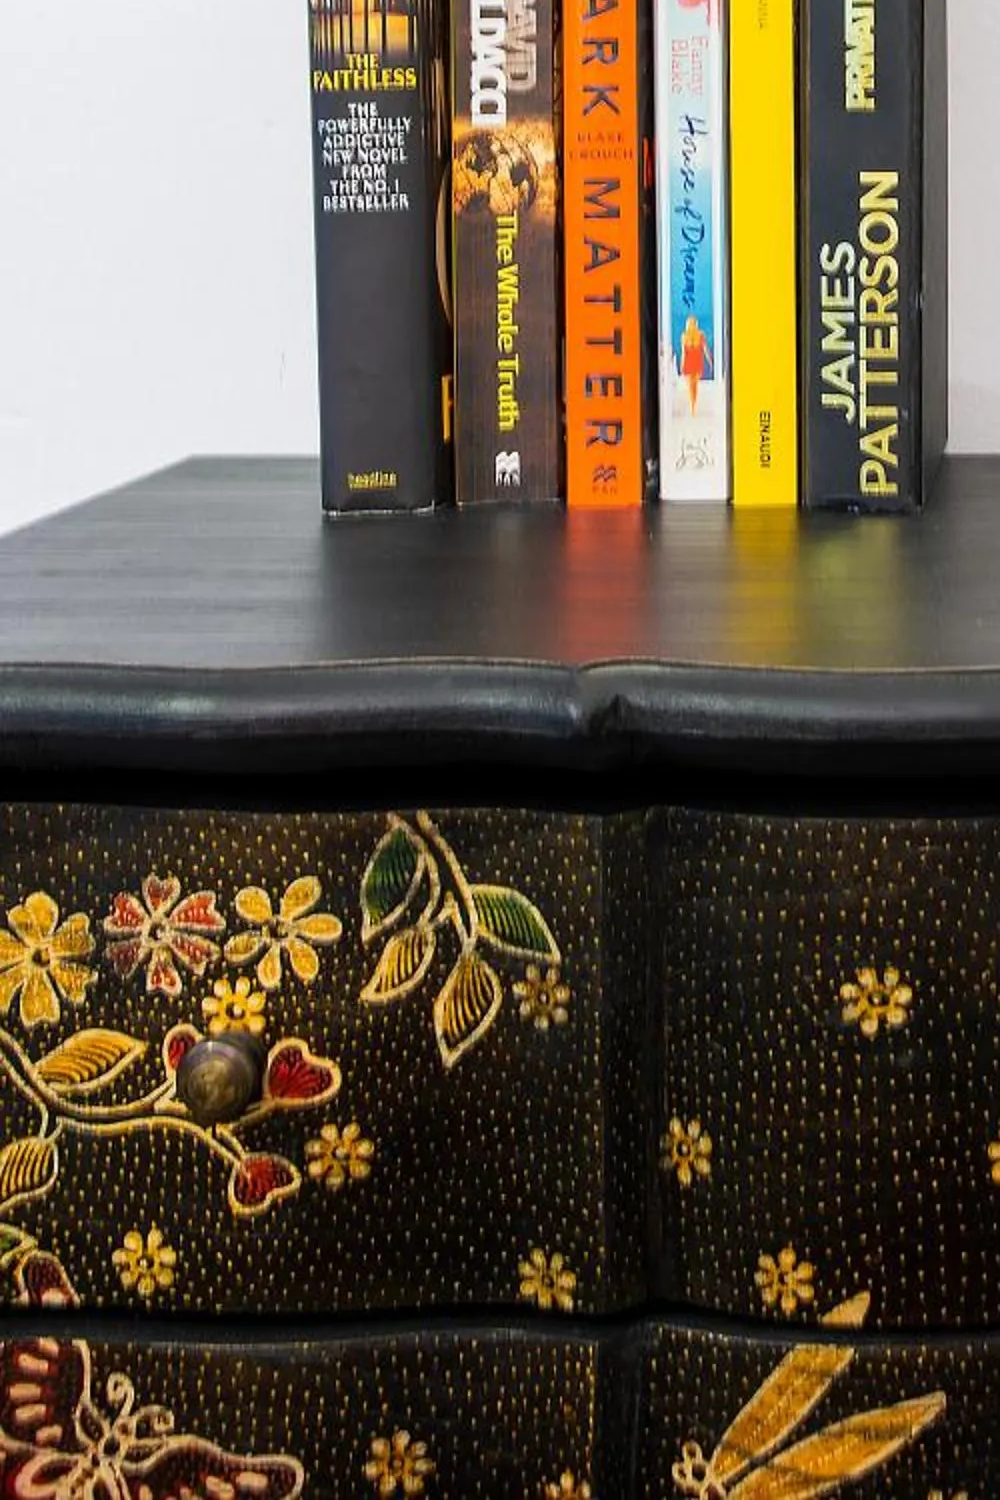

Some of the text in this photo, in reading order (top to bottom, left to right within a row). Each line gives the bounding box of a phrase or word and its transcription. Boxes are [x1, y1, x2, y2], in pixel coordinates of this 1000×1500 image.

[345, 52, 380, 70] THE
[313, 67, 417, 92] FAITHLESS
[347, 101, 378, 118] THE
[317, 116, 412, 135] POWERFULLY
[323, 132, 405, 149] ADDICTIVE
[323, 147, 408, 166] NEW NOVEL
[678, 113, 708, 191] House
[342, 164, 387, 180] FROM
[329, 180, 360, 196] THE
[323, 193, 410, 213] BESTSELLER
[680, 222, 705, 308] Dreams
[496, 210, 520, 432] The Whole Truth
[584, 177, 623, 448] MATTER
[820, 241, 855, 424] JAMES
[858, 171, 899, 496] PATTERSON
[759, 411, 771, 469] EINAUDI
